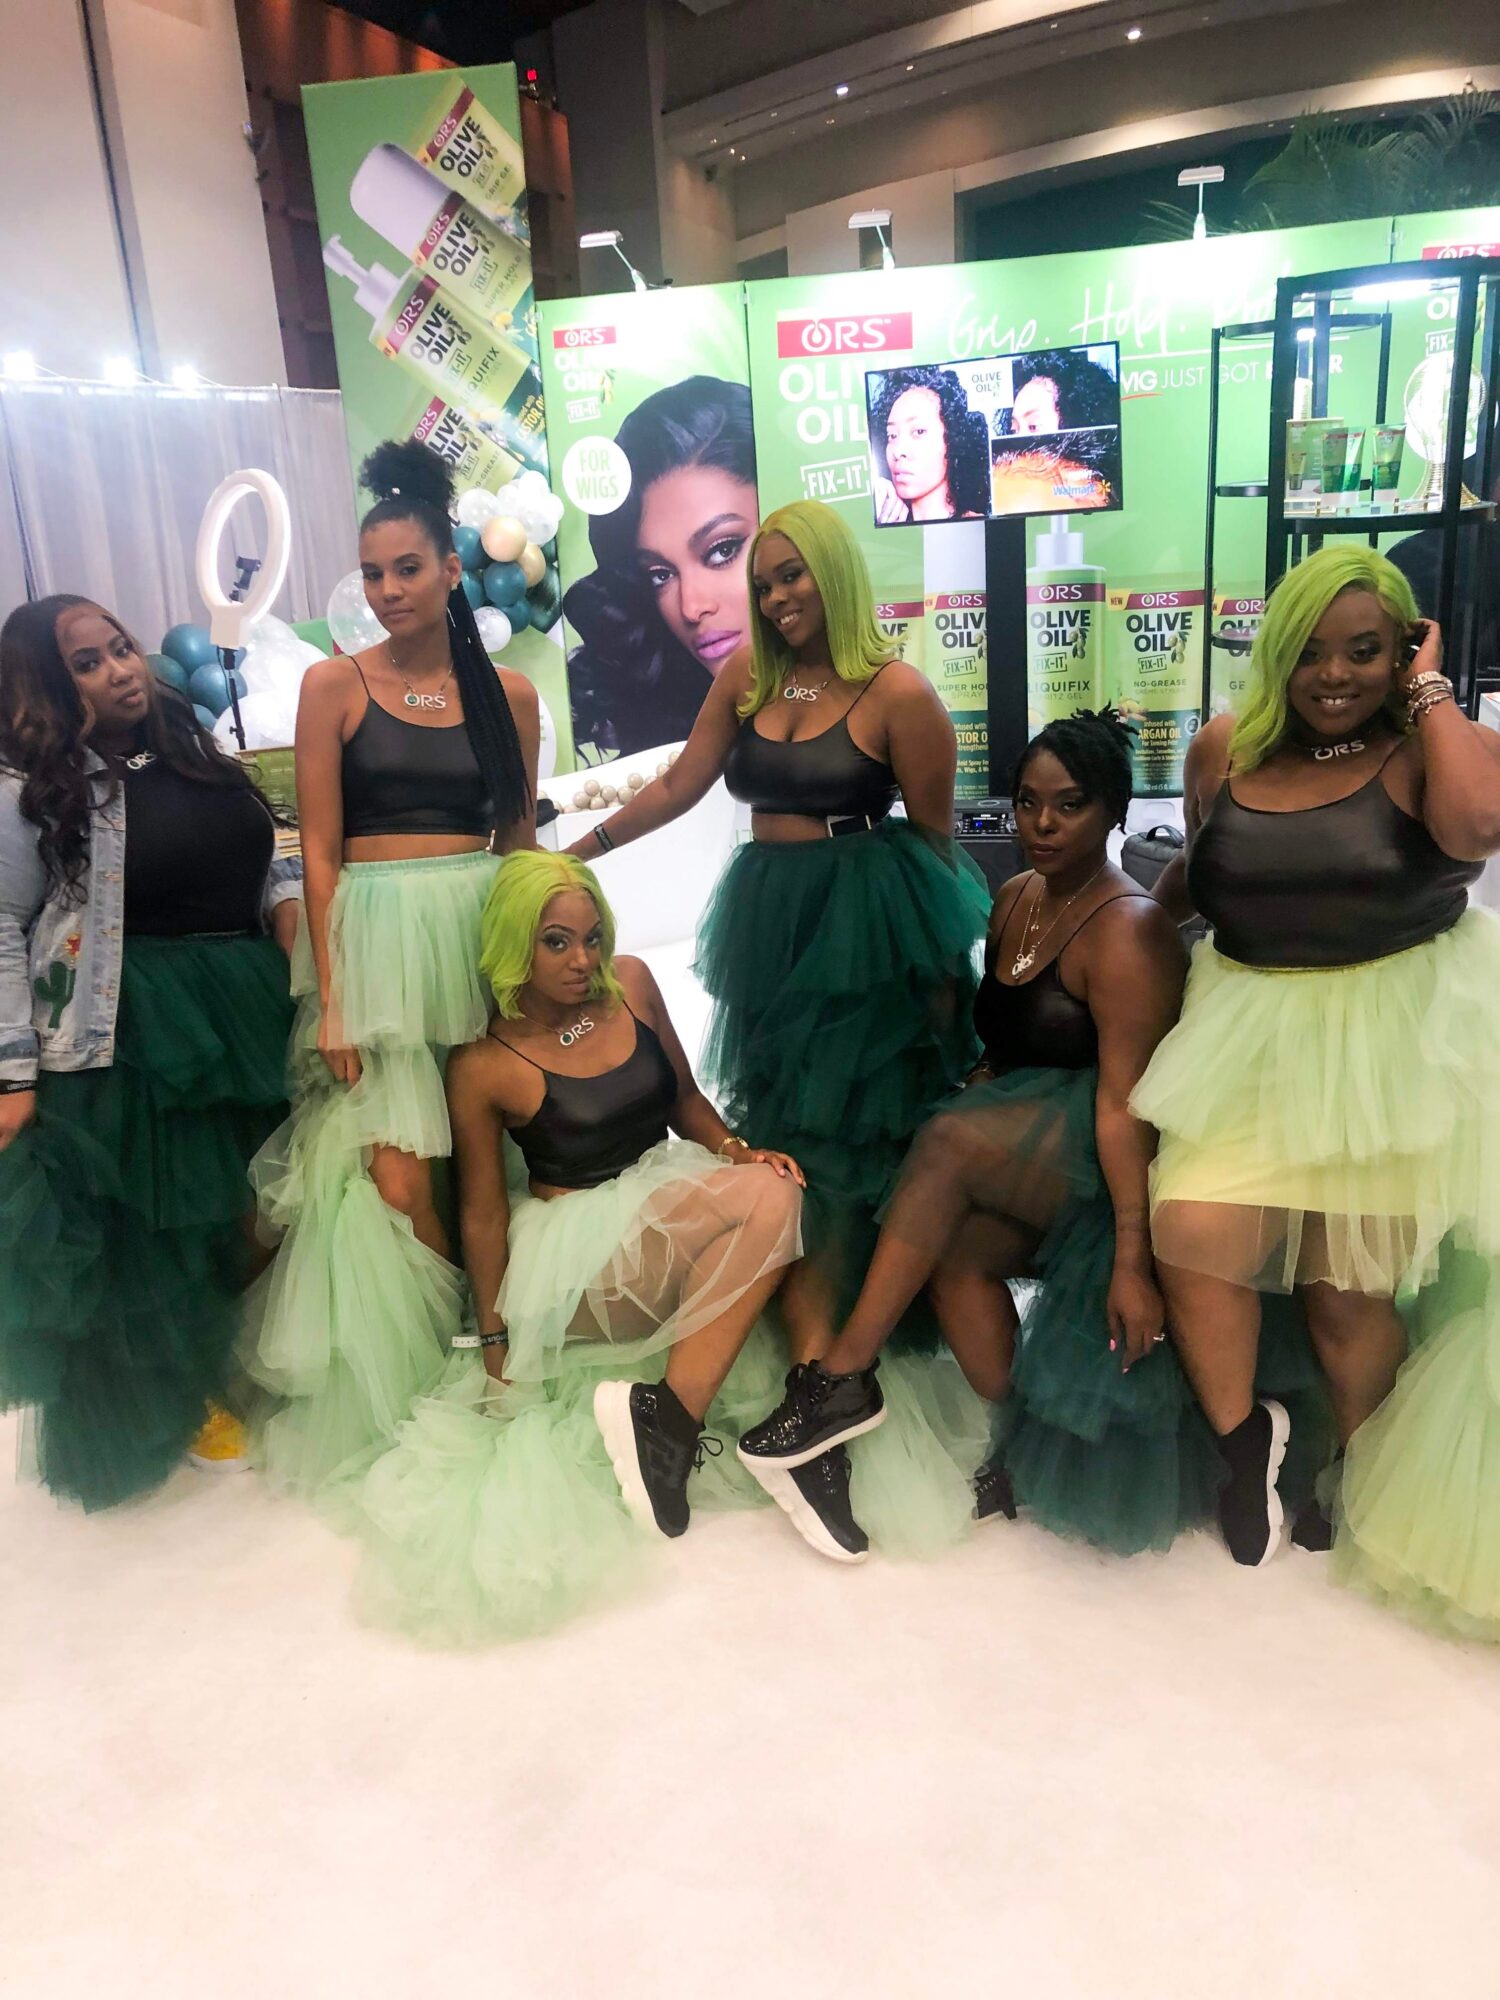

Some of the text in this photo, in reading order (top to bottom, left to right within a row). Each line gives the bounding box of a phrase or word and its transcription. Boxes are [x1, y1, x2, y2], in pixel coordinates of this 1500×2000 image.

[433, 116, 457, 148] ORS
[440, 116, 481, 171] OLIVE
[457, 148, 484, 177] OIL
[426, 213, 450, 246] ORS
[433, 212, 475, 270] OLIVE
[451, 243, 479, 276] OIL
[395, 295, 425, 336] ORS
[410, 302, 452, 359] OLIVE
[563, 327, 607, 346] ORS
[801, 317, 887, 352] ORS
[427, 334, 456, 365] OIL
[563, 371, 601, 392] OIL
[971, 371, 1003, 384] OLIVE
[1120, 369, 1158, 393] MG
[1161, 365, 1207, 389] JUST
[1219, 361, 1260, 384] GOT
[975, 382, 993, 394] OIL
[414, 408, 438, 440] ORS
[428, 407, 462, 455] LIVE
[796, 403, 869, 444] OIL
[580, 449, 610, 472] FOR
[576, 475, 619, 499] WIGS
[807, 464, 863, 497] FIX-IT
[1053, 483, 1095, 496] Walmart
[948, 594, 983, 607] ORS
[1039, 584, 1082, 601] ORS
[1141, 592, 1179, 607] ORS
[875, 604, 895, 618] RS
[1235, 600, 1263, 613] OR
[935, 612, 987, 631] OLIV
[1030, 609, 1091, 629] OLIVE
[1126, 611, 1193, 633] OLIVE
[942, 631, 979, 649] OIL
[1037, 629, 1073, 648] OIL
[1134, 633, 1172, 653] OIL
[945, 659, 973, 674] FIX-IT
[1036, 656, 1064, 670] FIX-IT
[1140, 657, 1164, 670] FIX-IT
[937, 684, 967, 692] SUPER
[1028, 680, 1091, 693] LIQUIFIX
[1134, 679, 1187, 688] NO-GREASE
[404, 693, 447, 709] ORS
[783, 686, 819, 702] ORS
[955, 731, 979, 744] STOR
[1138, 728, 1182, 740] ARGAN OIL
[1314, 739, 1366, 760] ORS
[559, 1016, 595, 1046] ORS
